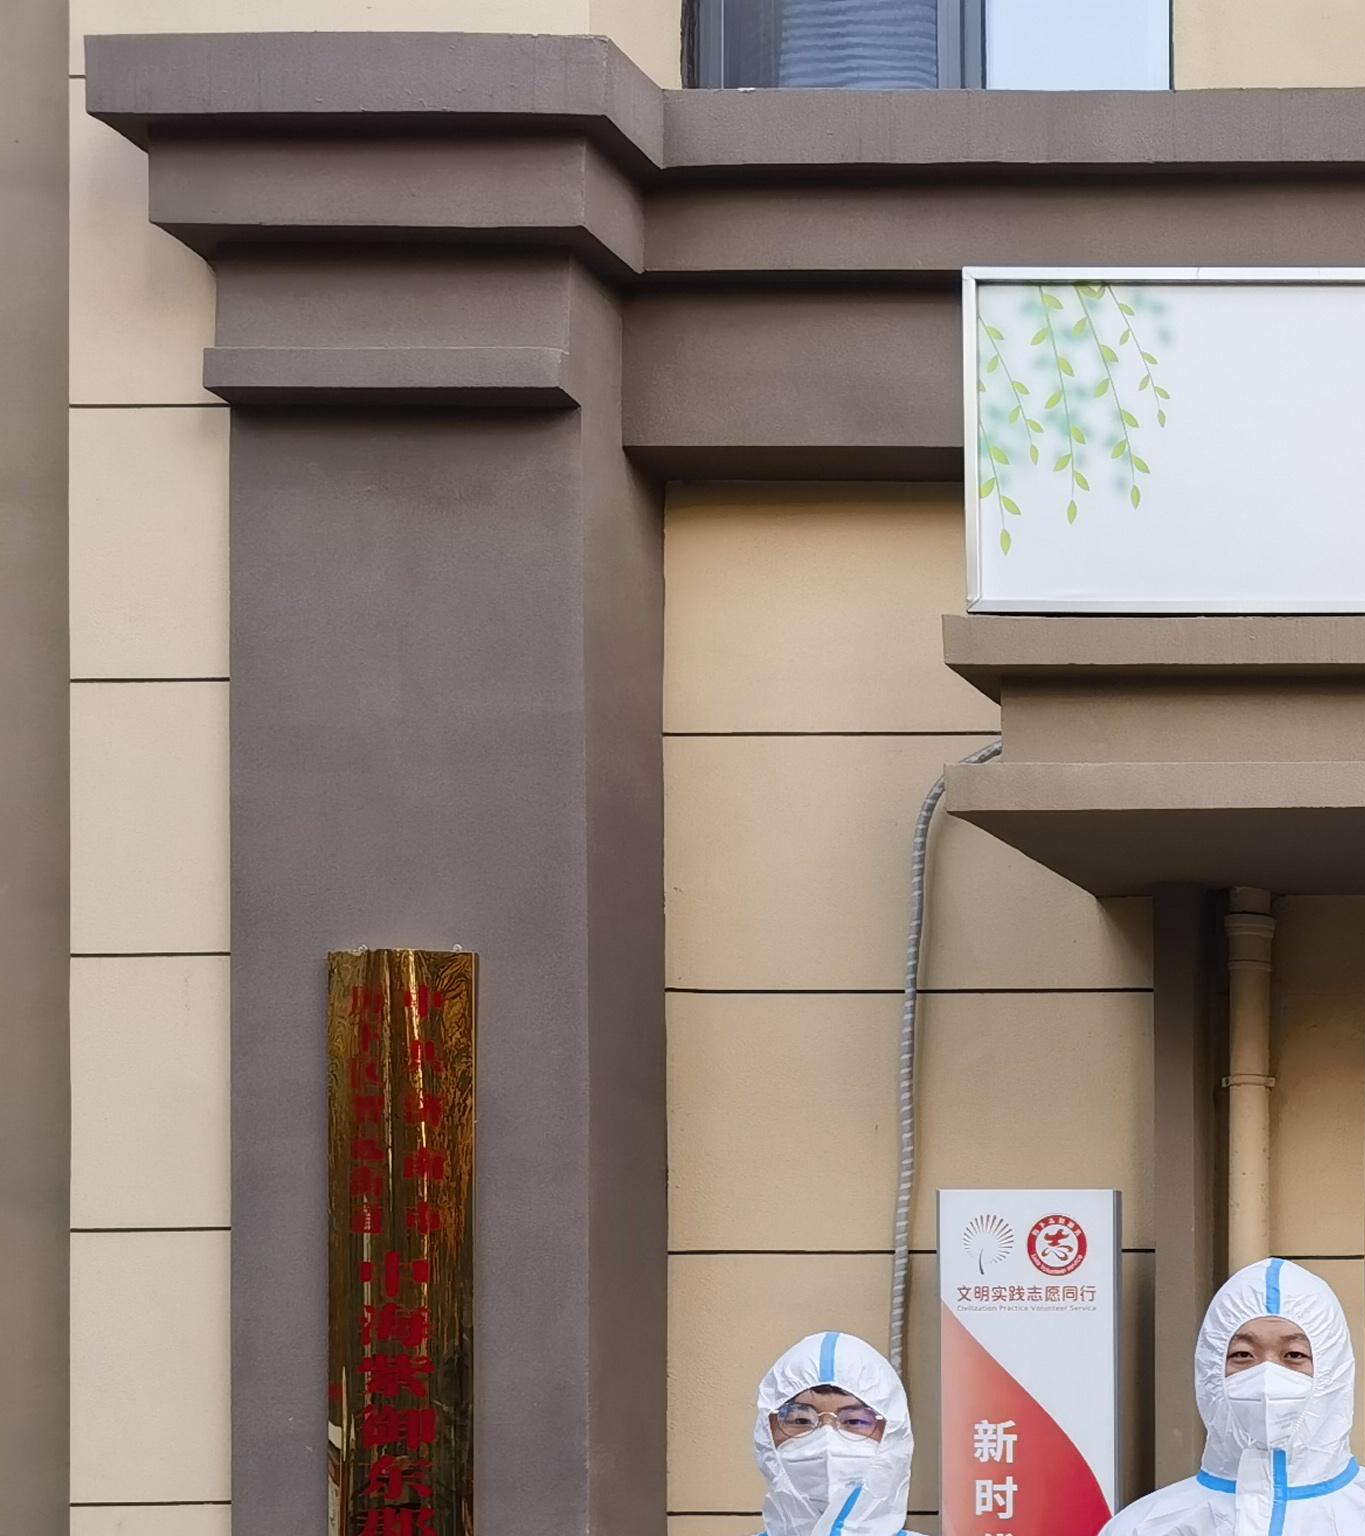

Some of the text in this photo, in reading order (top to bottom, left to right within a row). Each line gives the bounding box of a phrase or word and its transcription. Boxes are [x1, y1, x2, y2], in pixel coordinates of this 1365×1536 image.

[957, 1285, 1097, 1302] 文明实践志愿同行
